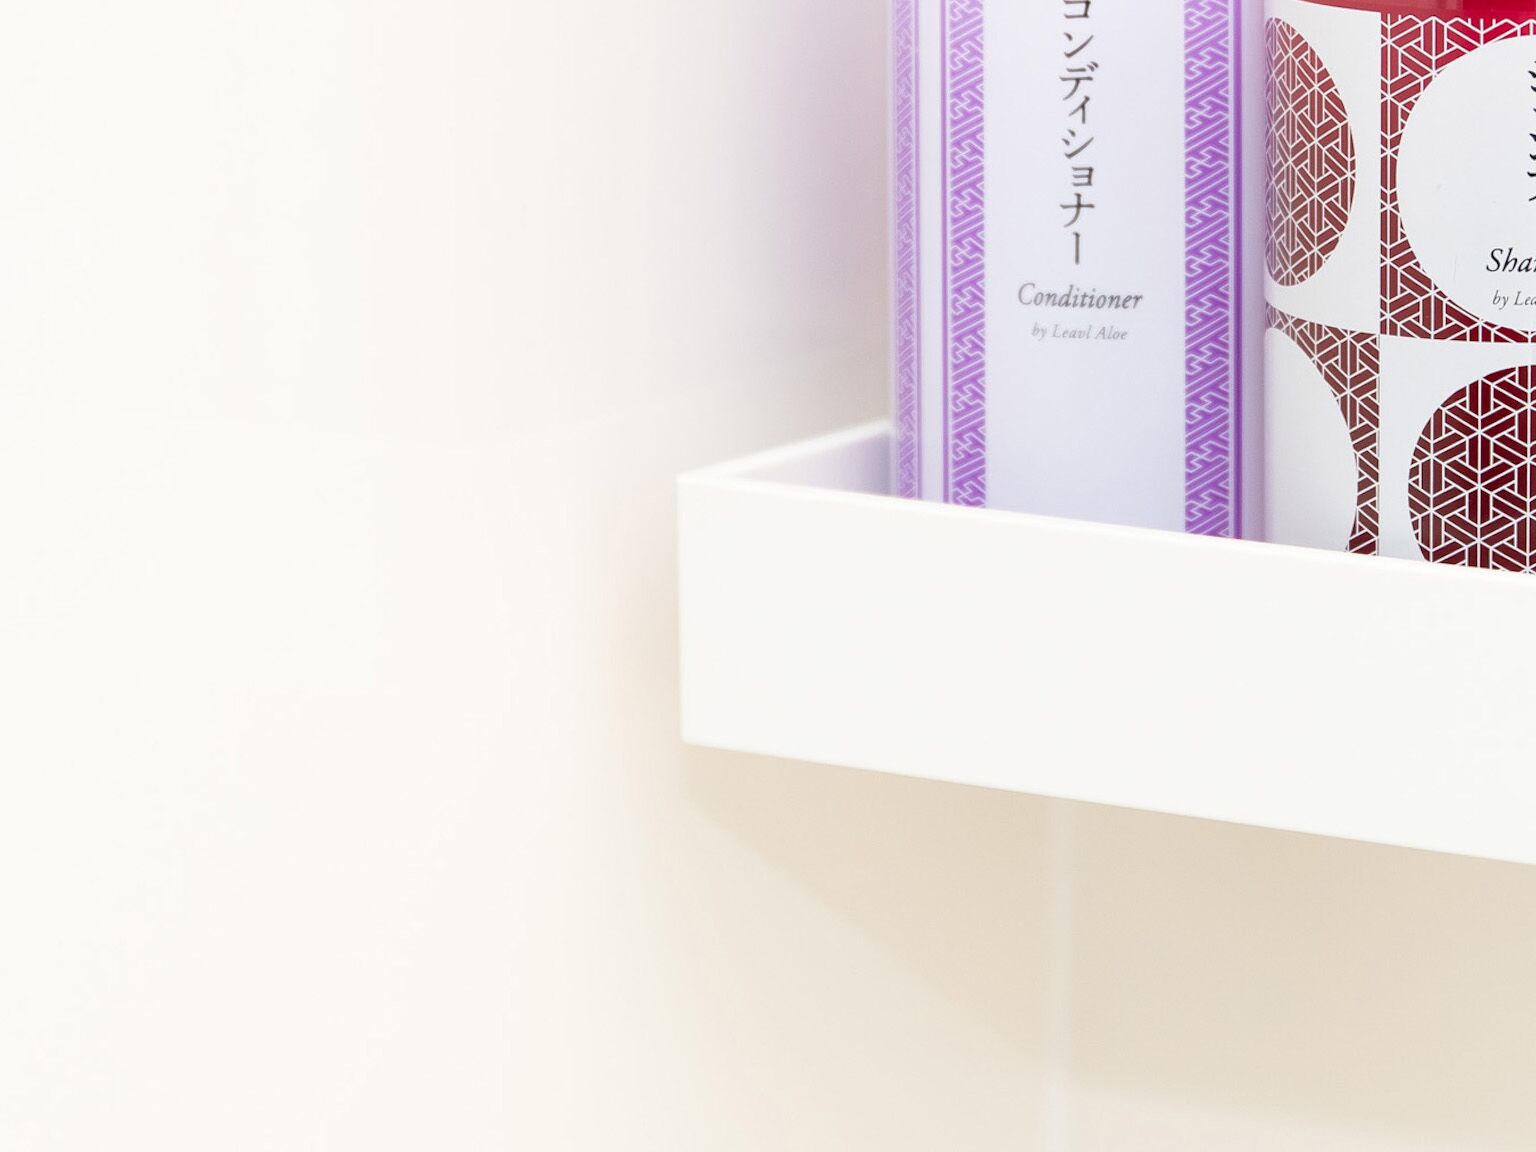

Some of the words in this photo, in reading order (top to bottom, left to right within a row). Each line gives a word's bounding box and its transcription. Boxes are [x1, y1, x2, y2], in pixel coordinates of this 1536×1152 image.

[1017, 281, 1144, 310] Conditioner
[1492, 289, 1509, 310] by
[1031, 321, 1048, 342] by
[1094, 325, 1128, 341] Aloe
